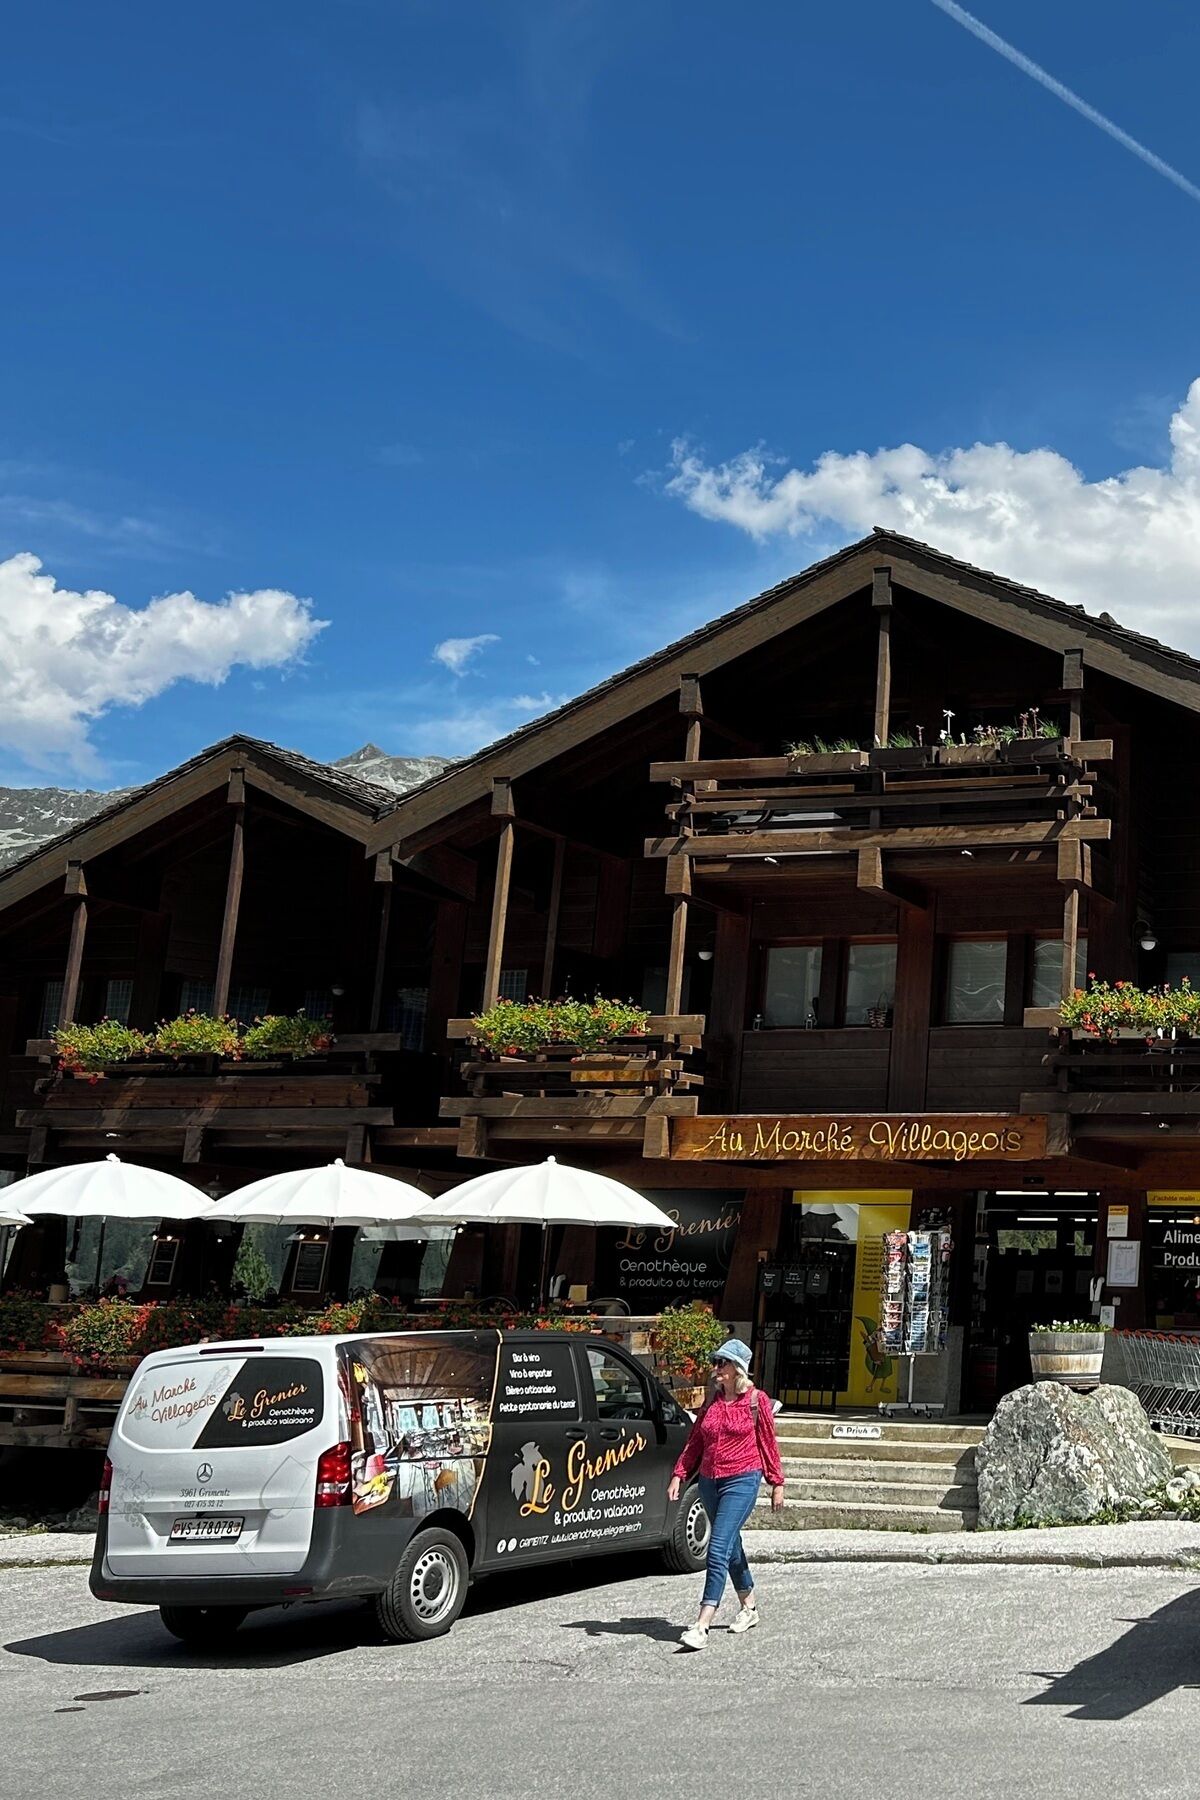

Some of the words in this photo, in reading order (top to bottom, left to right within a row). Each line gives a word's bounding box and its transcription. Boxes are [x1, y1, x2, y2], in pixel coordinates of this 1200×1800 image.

[693, 1121, 743, 1153] Au
[749, 1121, 854, 1156] Marché
[869, 1121, 1022, 1161] Villageois
[654, 1206, 742, 1252] Grenier
[629, 1277, 673, 1288] produits
[676, 1278, 690, 1288] du
[693, 1278, 725, 1288] terroir
[128, 1396, 148, 1415] Au
[151, 1378, 197, 1408] Marché
[152, 1394, 217, 1424] Villageois
[227, 1398, 247, 1422] Le
[250, 1382, 308, 1419] Grenier
[248, 1418, 278, 1429] produits
[519, 1459, 555, 1518] Le
[562, 1428, 648, 1511] Grenier
[179, 1488, 197, 1498] 3961
[591, 1484, 646, 1502] Oenothèque
[554, 1511, 562, 1525] &
[563, 1507, 601, 1527] produits
[603, 1502, 644, 1518] valaisans
